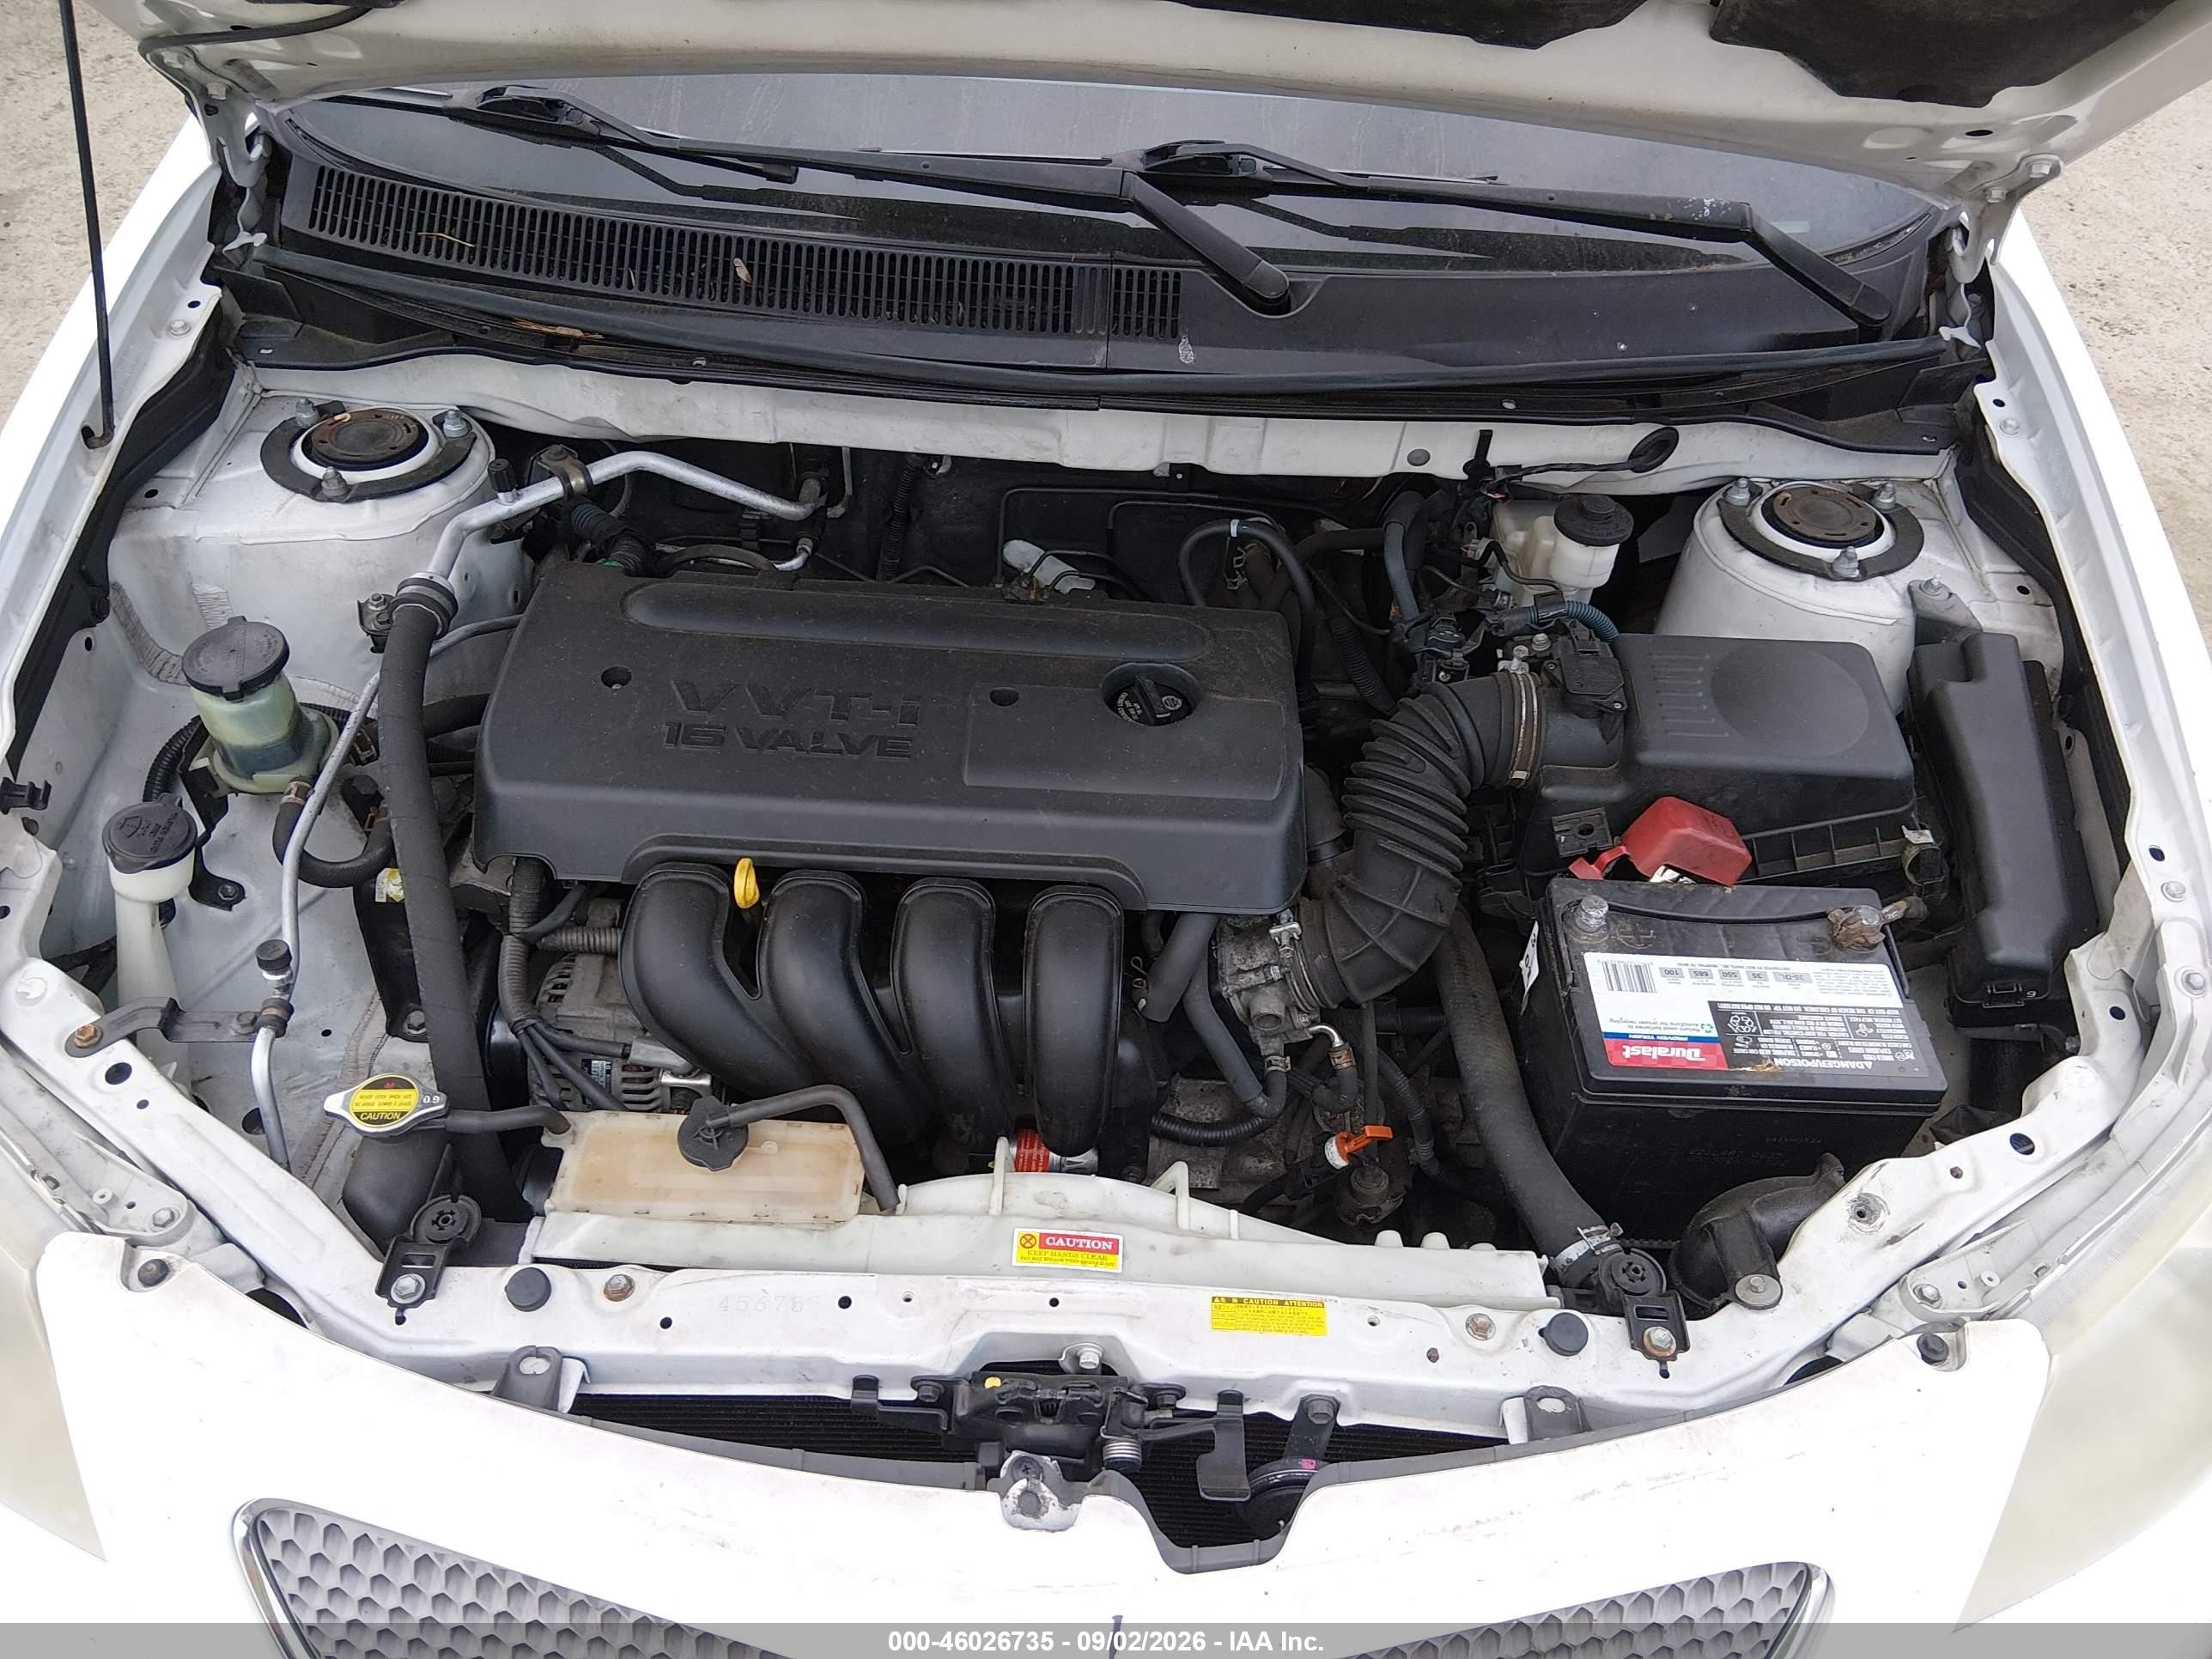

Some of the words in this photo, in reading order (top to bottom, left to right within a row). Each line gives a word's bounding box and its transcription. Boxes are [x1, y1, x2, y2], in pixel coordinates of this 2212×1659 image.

[669, 678, 921, 729] VVT-i
[664, 722, 726, 749] 16
[735, 726, 914, 761] VALVE
[1621, 1044, 1706, 1061] Duralast
[1045, 1237, 1113, 1250] CAUTION
